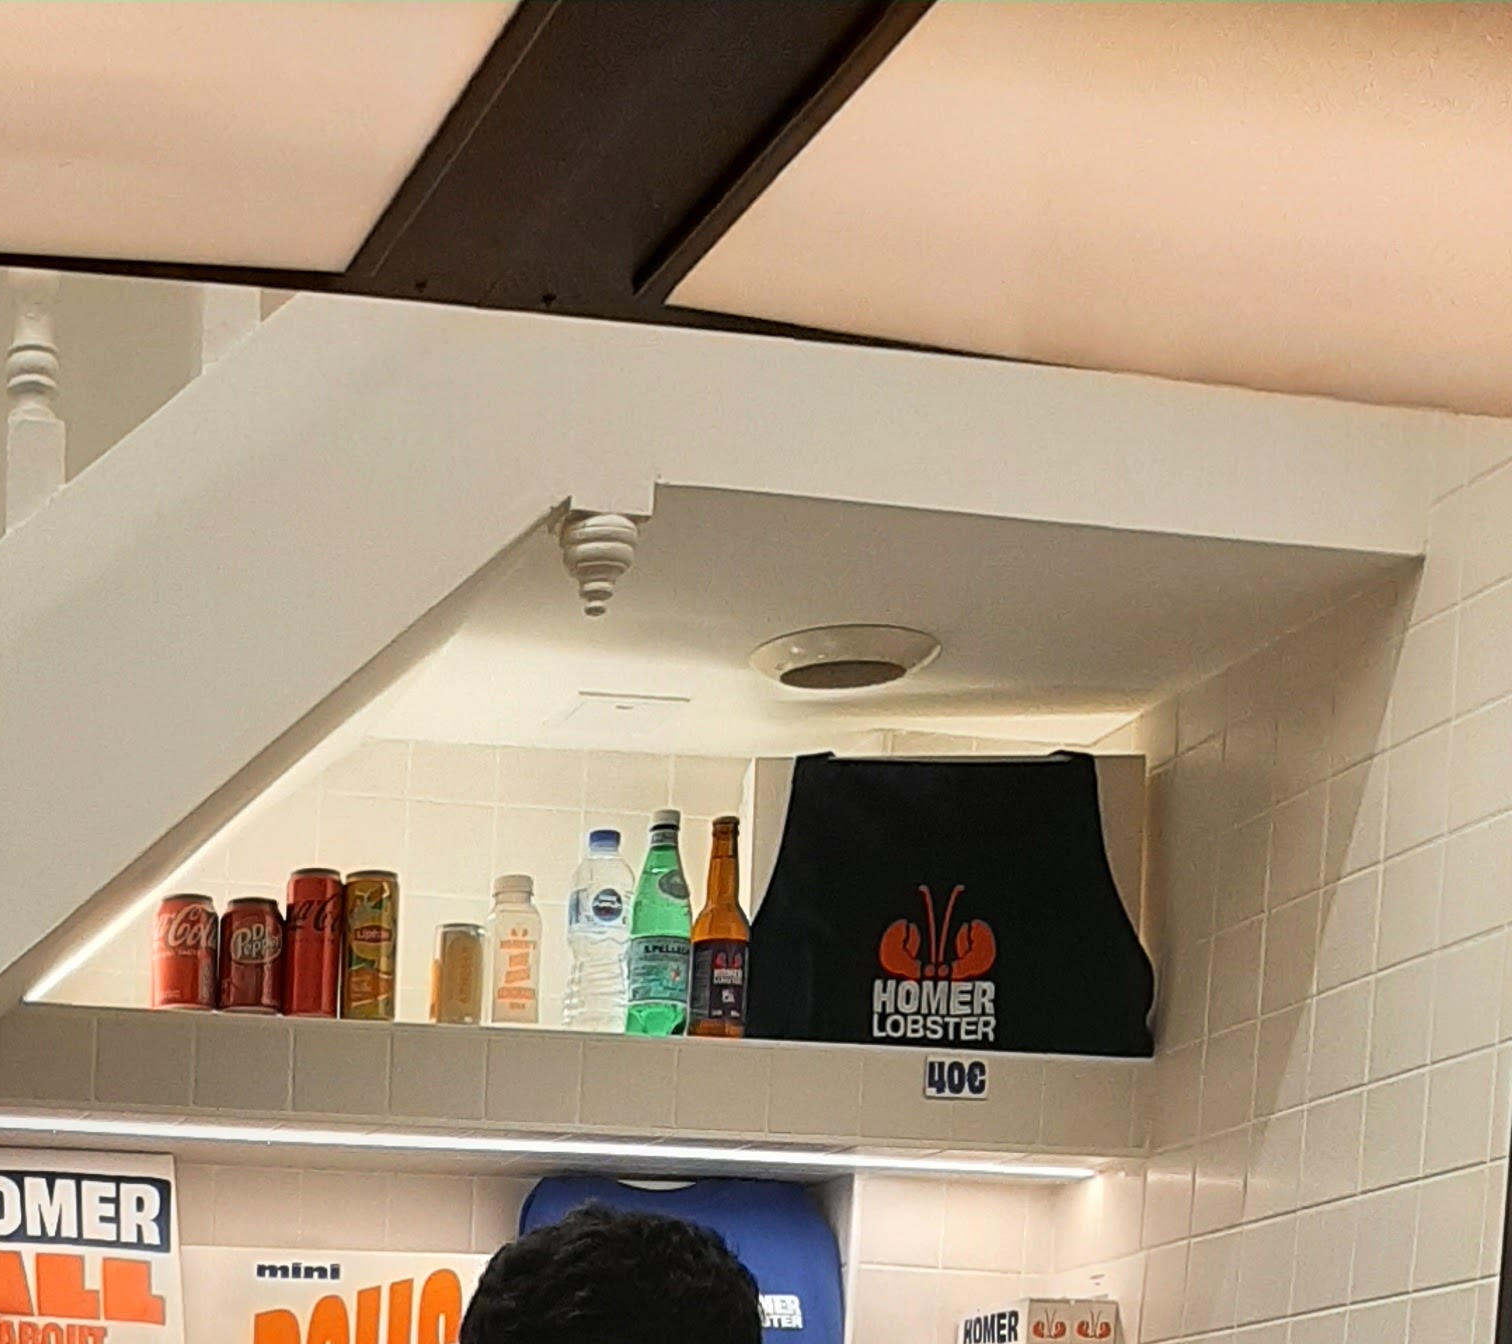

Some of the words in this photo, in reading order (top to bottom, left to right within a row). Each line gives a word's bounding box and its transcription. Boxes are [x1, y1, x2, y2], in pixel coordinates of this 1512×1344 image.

[873, 979, 995, 1015] HOMER
[872, 1014, 996, 1042] LOBSTER
[928, 1061, 986, 1094] 40€
[256, 1262, 341, 1280] mini
